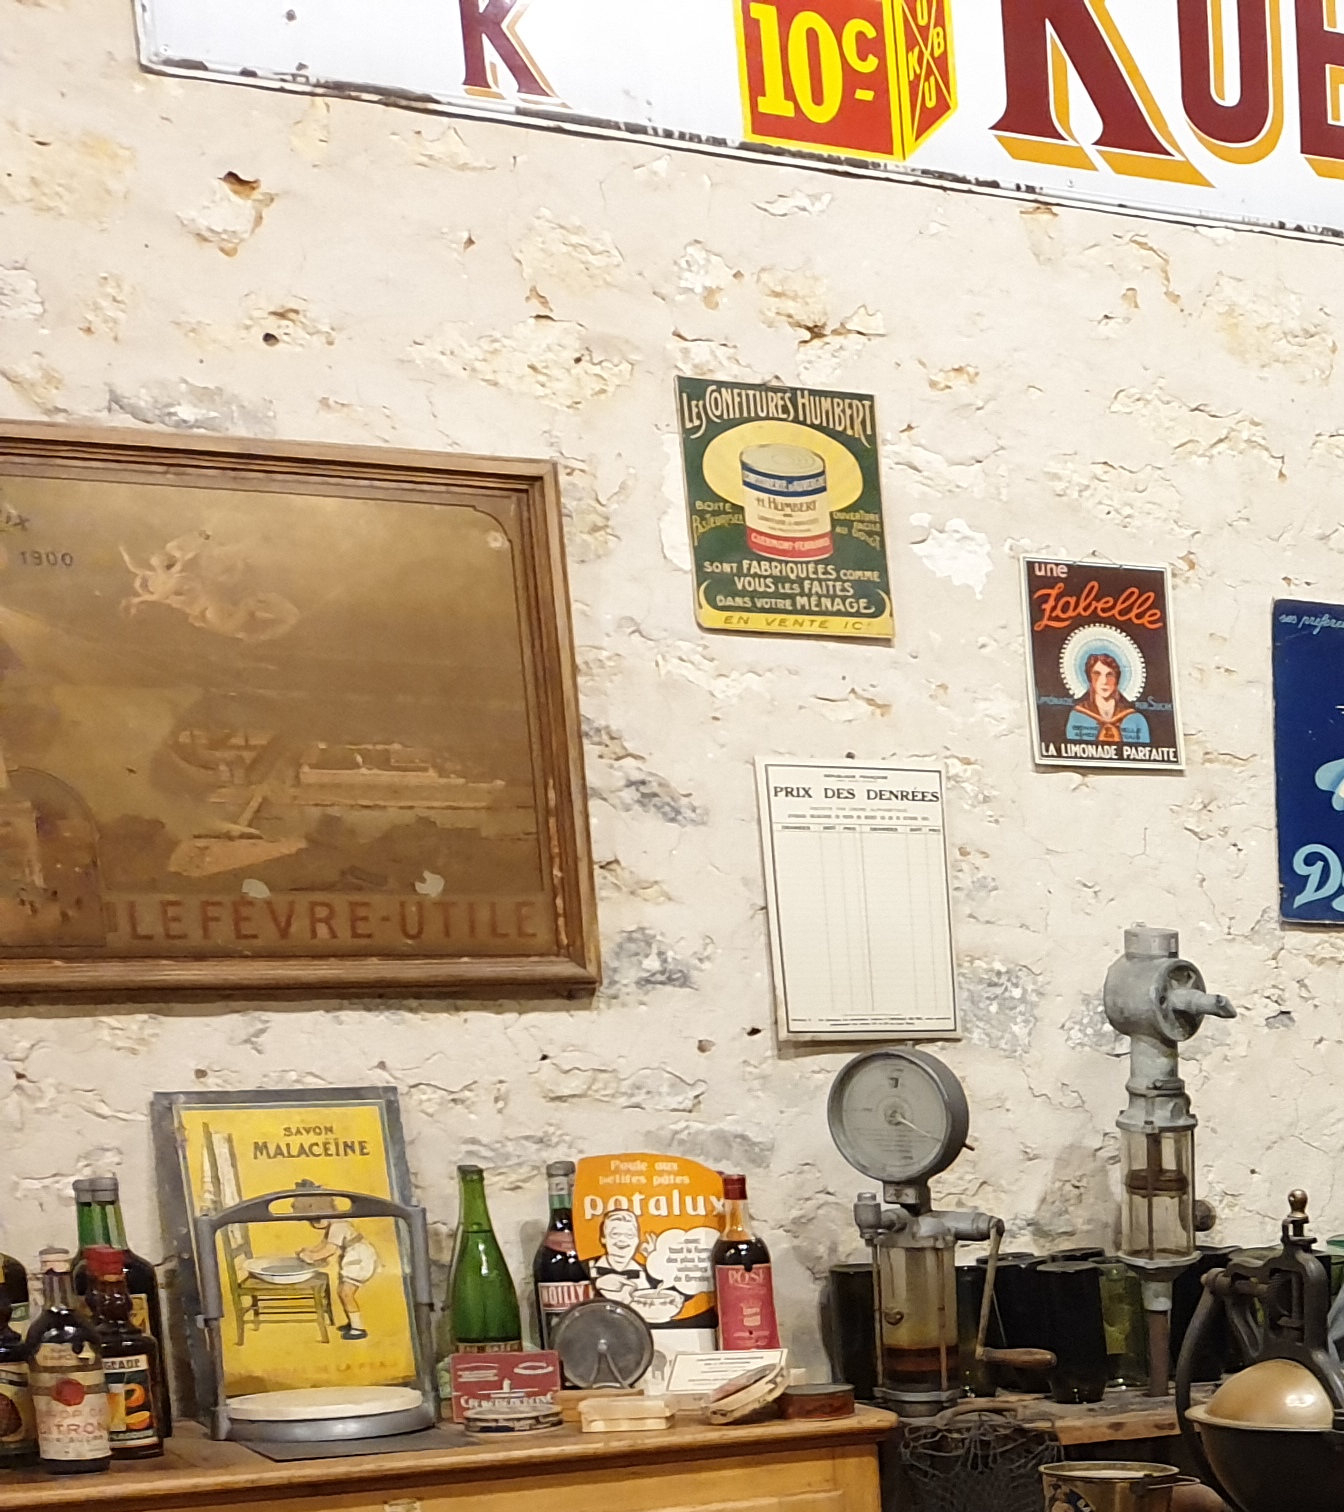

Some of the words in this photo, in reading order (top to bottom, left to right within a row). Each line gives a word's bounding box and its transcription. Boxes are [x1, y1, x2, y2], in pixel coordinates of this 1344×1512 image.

[707, 385, 795, 424] CONFITURES
[798, 390, 873, 447] HUMBERT
[703, 561, 737, 573] SONT
[742, 560, 837, 580] FABRIQUÉES
[734, 576, 775, 592] VOUS
[778, 582, 799, 593] LES
[804, 580, 854, 596] FAITES
[716, 595, 752, 607] DANS
[756, 597, 793, 610] VOTRE
[796, 594, 875, 614] MÉNAGE
[723, 615, 750, 625] EN
[766, 618, 828, 629] VENTE
[1042, 742, 1058, 756] LA
[1061, 743, 1118, 759] LIMONADE
[1124, 746, 1177, 761] PARFAITE
[773, 786, 813, 799] PRIX
[824, 787, 856, 800] DES
[866, 787, 940, 802] DENRÉES
[283, 1124, 335, 1139] SAVON
